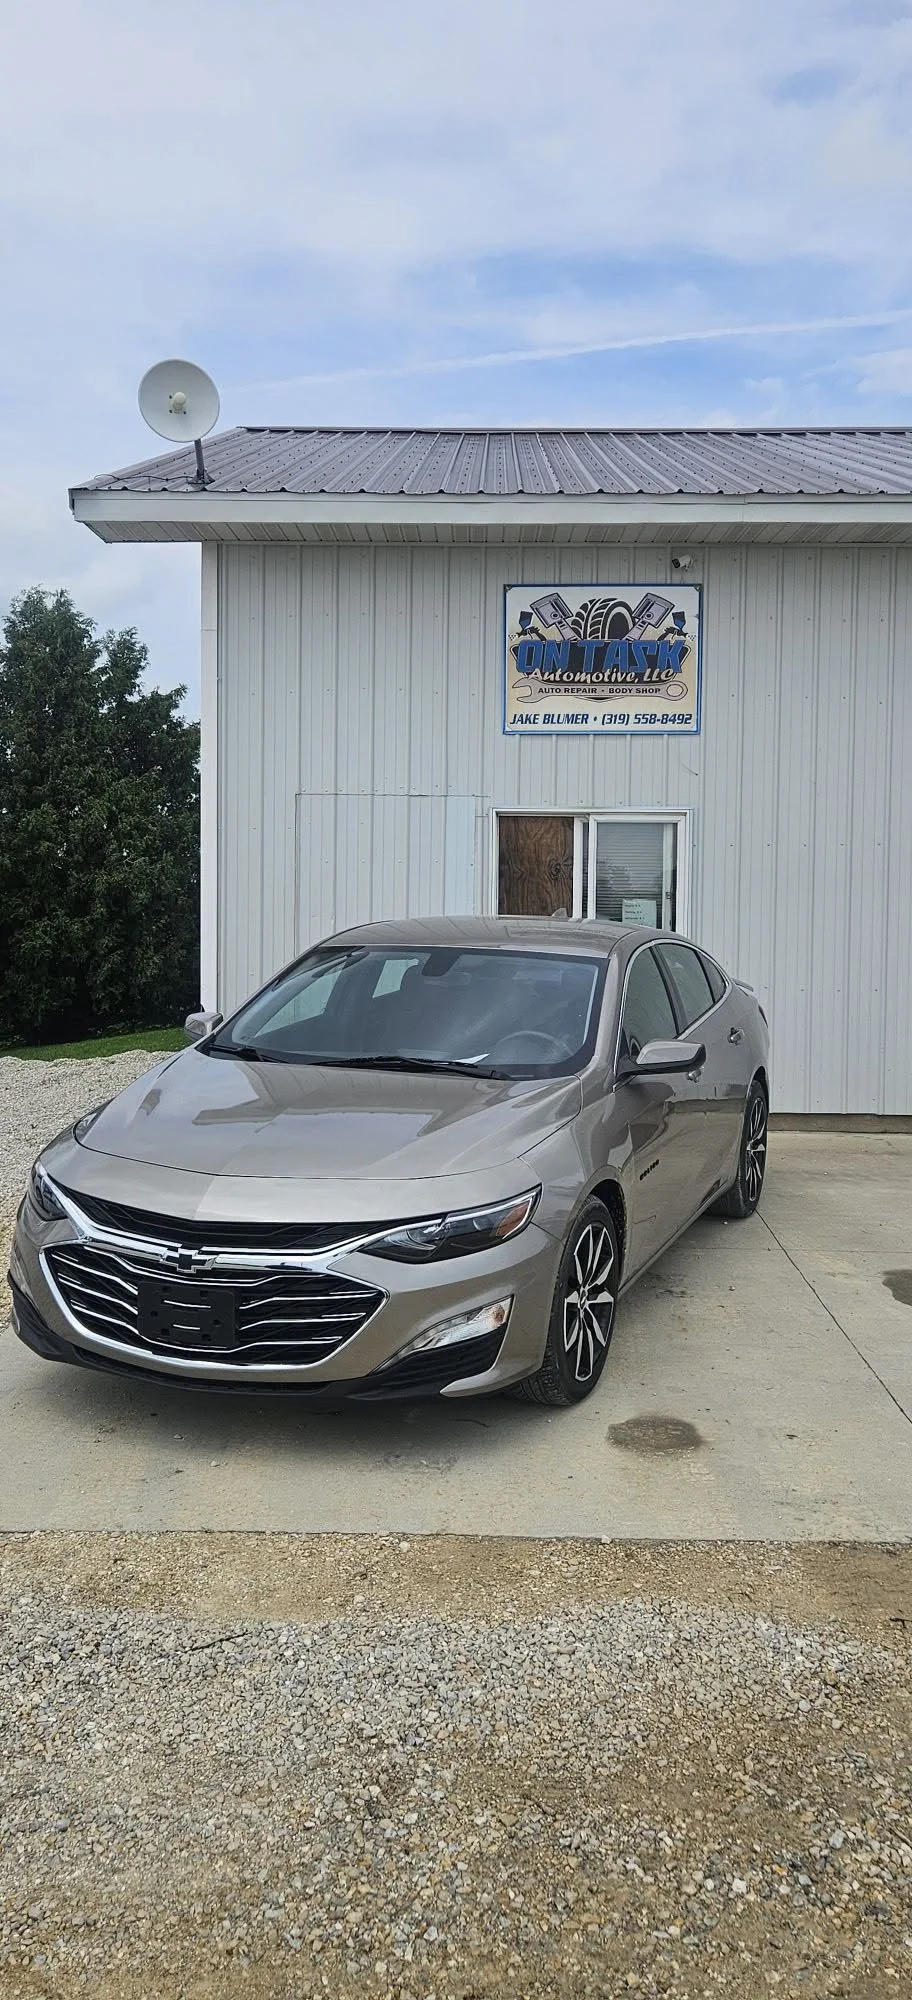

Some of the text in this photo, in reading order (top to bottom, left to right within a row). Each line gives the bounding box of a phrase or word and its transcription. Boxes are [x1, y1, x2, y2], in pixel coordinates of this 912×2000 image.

[516, 640, 686, 672] ON TASK
[529, 668, 674, 684] Automotive, LLC
[510, 713, 692, 726] JAKE BLUMER (319) 558-8492
